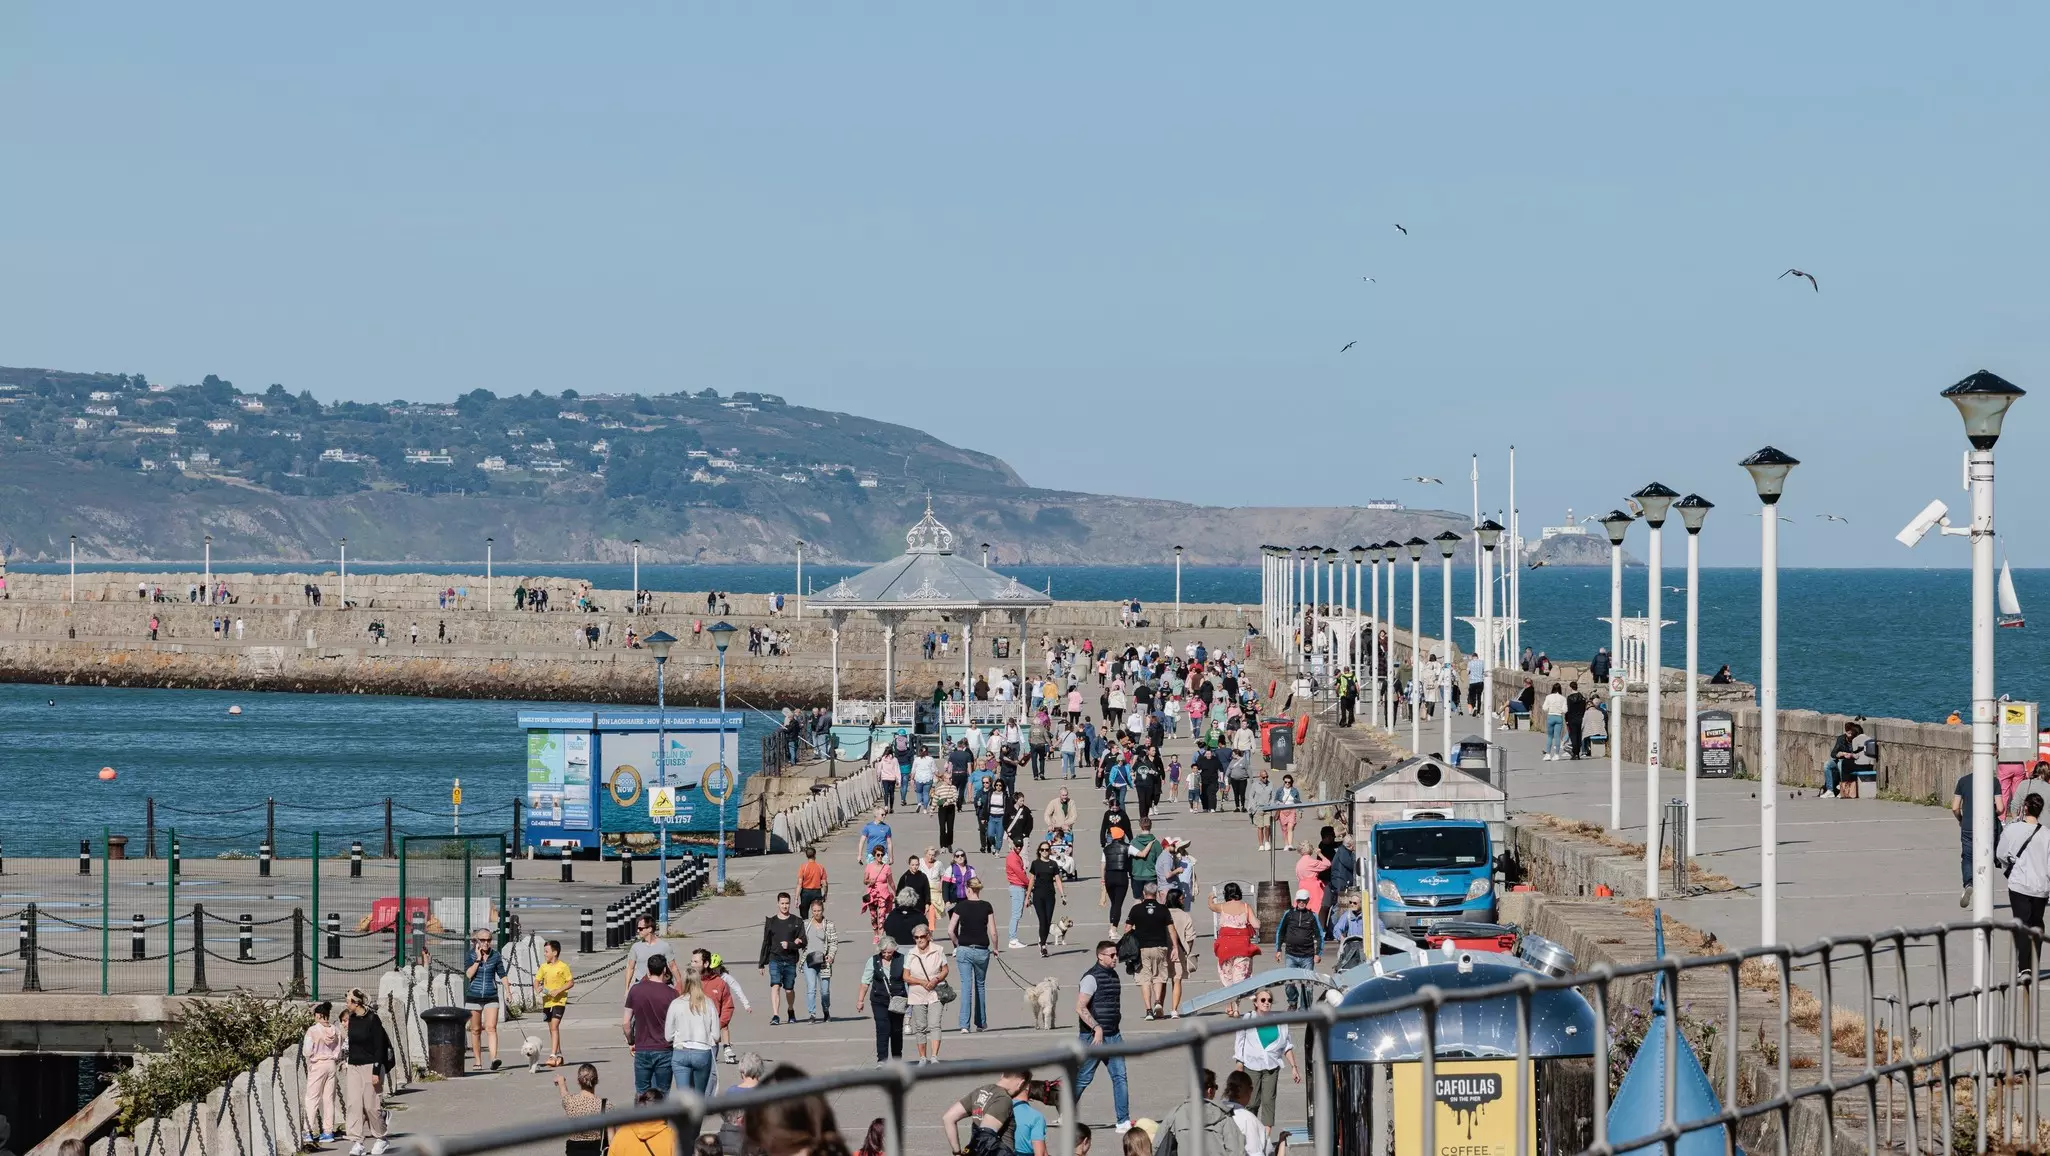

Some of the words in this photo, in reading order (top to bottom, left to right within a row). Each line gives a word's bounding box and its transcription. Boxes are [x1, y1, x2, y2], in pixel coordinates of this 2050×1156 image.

[673, 717, 696, 725] DALKEY
[729, 717, 743, 725] CITY
[652, 751, 678, 759] DULIN
[679, 750, 693, 759] BAY
[655, 758, 686, 767] CUISES
[1435, 1078, 1495, 1096] CAFOLLAS
